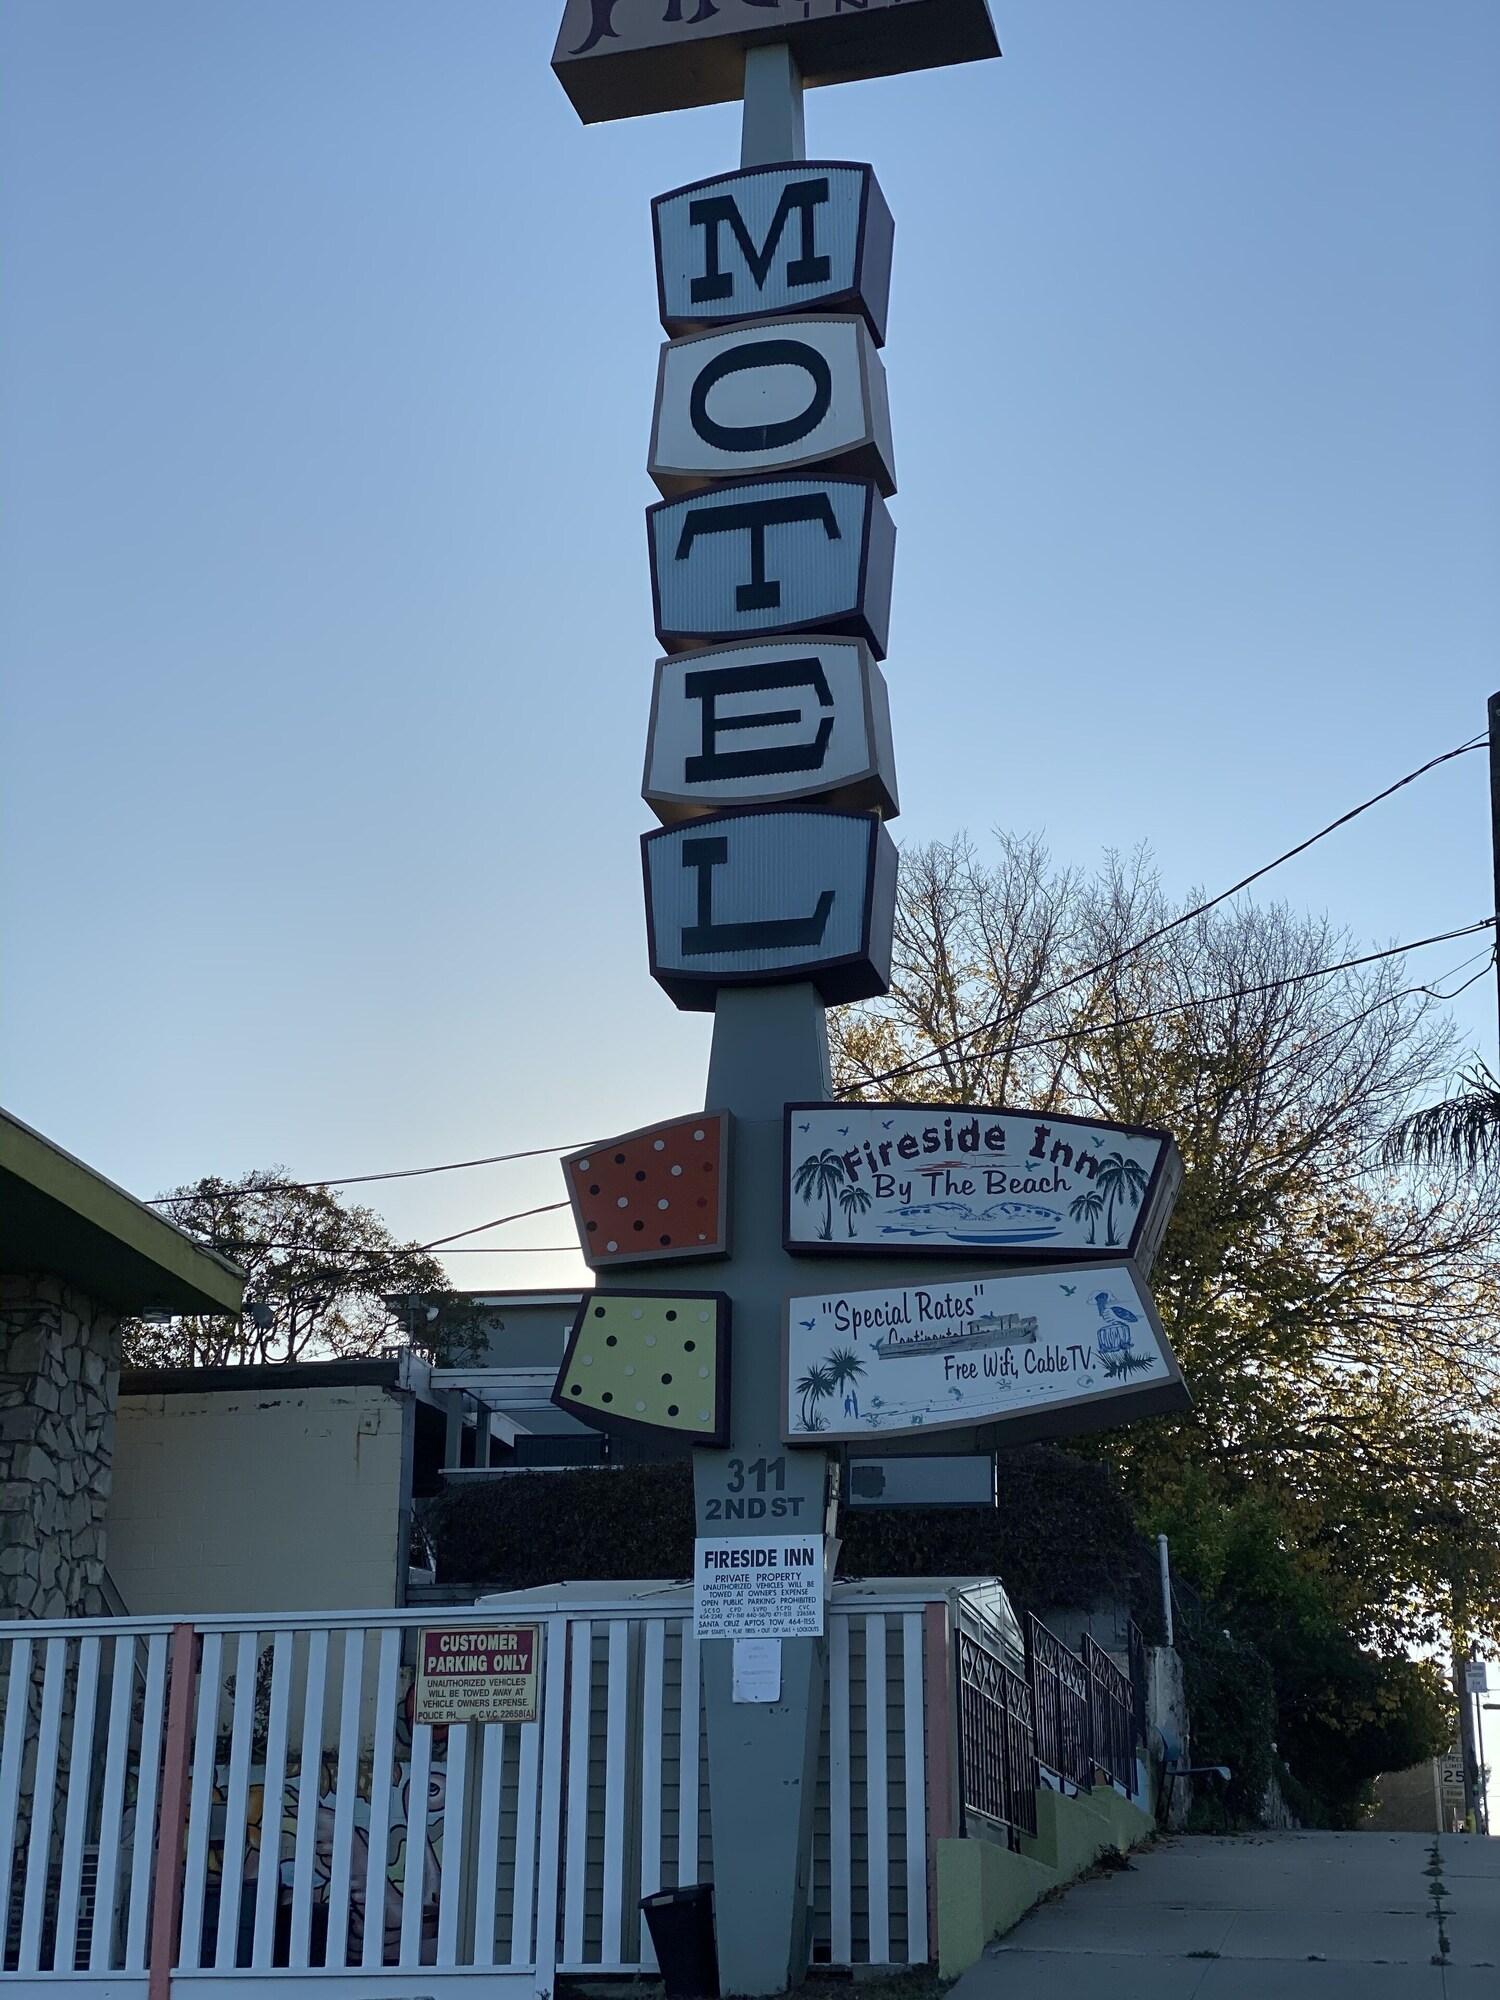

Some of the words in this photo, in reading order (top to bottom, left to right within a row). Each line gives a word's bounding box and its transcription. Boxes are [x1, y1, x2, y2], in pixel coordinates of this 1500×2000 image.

[675, 177, 842, 956] MOTEL
[841, 1116, 1006, 1183] Fireside
[1029, 1123, 1100, 1180] Inn
[872, 1173, 912, 1204] By
[921, 1169, 976, 1197] The
[982, 1166, 1072, 1195] Beach
[822, 1291, 912, 1341] "Special
[915, 1283, 984, 1323] Rates"
[944, 1355, 979, 1381] Free
[983, 1346, 1019, 1379] Wifi,
[727, 1456, 787, 1493] 311
[704, 1497, 767, 1521] 2ND
[770, 1496, 805, 1518] ST
[704, 1548, 777, 1569] FIRESIDE
[784, 1547, 814, 1567] INN
[715, 1573, 750, 1583] PRIVATE
[756, 1571, 802, 1582] PROPERTY
[702, 1582, 752, 1591] UNAUTHORIZED
[756, 1581, 784, 1589] VEHICLES
[788, 1580, 803, 1588] WILL
[806, 1580, 815, 1588] BE
[709, 1591, 732, 1599] TOWED
[781, 1588, 809, 1596] EXPENSE
[722, 1598, 744, 1606] PUBLIC
[747, 1597, 776, 1605] PARKING
[780, 1596, 817, 1604] PROHIBITED
[698, 1620, 720, 1628] SANTA
[723, 1619, 740, 1627] CRUZ
[744, 1619, 765, 1627] APTOS
[769, 1618, 785, 1626] TOW
[440, 1633, 518, 1652] CUSTOMER
[427, 1655, 488, 1673] PARKING
[493, 1654, 528, 1671] ONLY
[427, 1679, 486, 1688] UNAUTHORIZED
[489, 1678, 526, 1687] VEHICLES
[428, 1689, 446, 1698] WILL
[449, 1689, 460, 1698] BE
[462, 1688, 490, 1697] TOWED
[492, 1688, 512, 1697] AWAY
[515, 1687, 525, 1696] AT
[423, 1699, 454, 1709] VEHICLE
[457, 1699, 490, 1708] OWNERS
[418, 1711, 444, 1720] POLICE
[1443, 1770, 1465, 1783] 25
